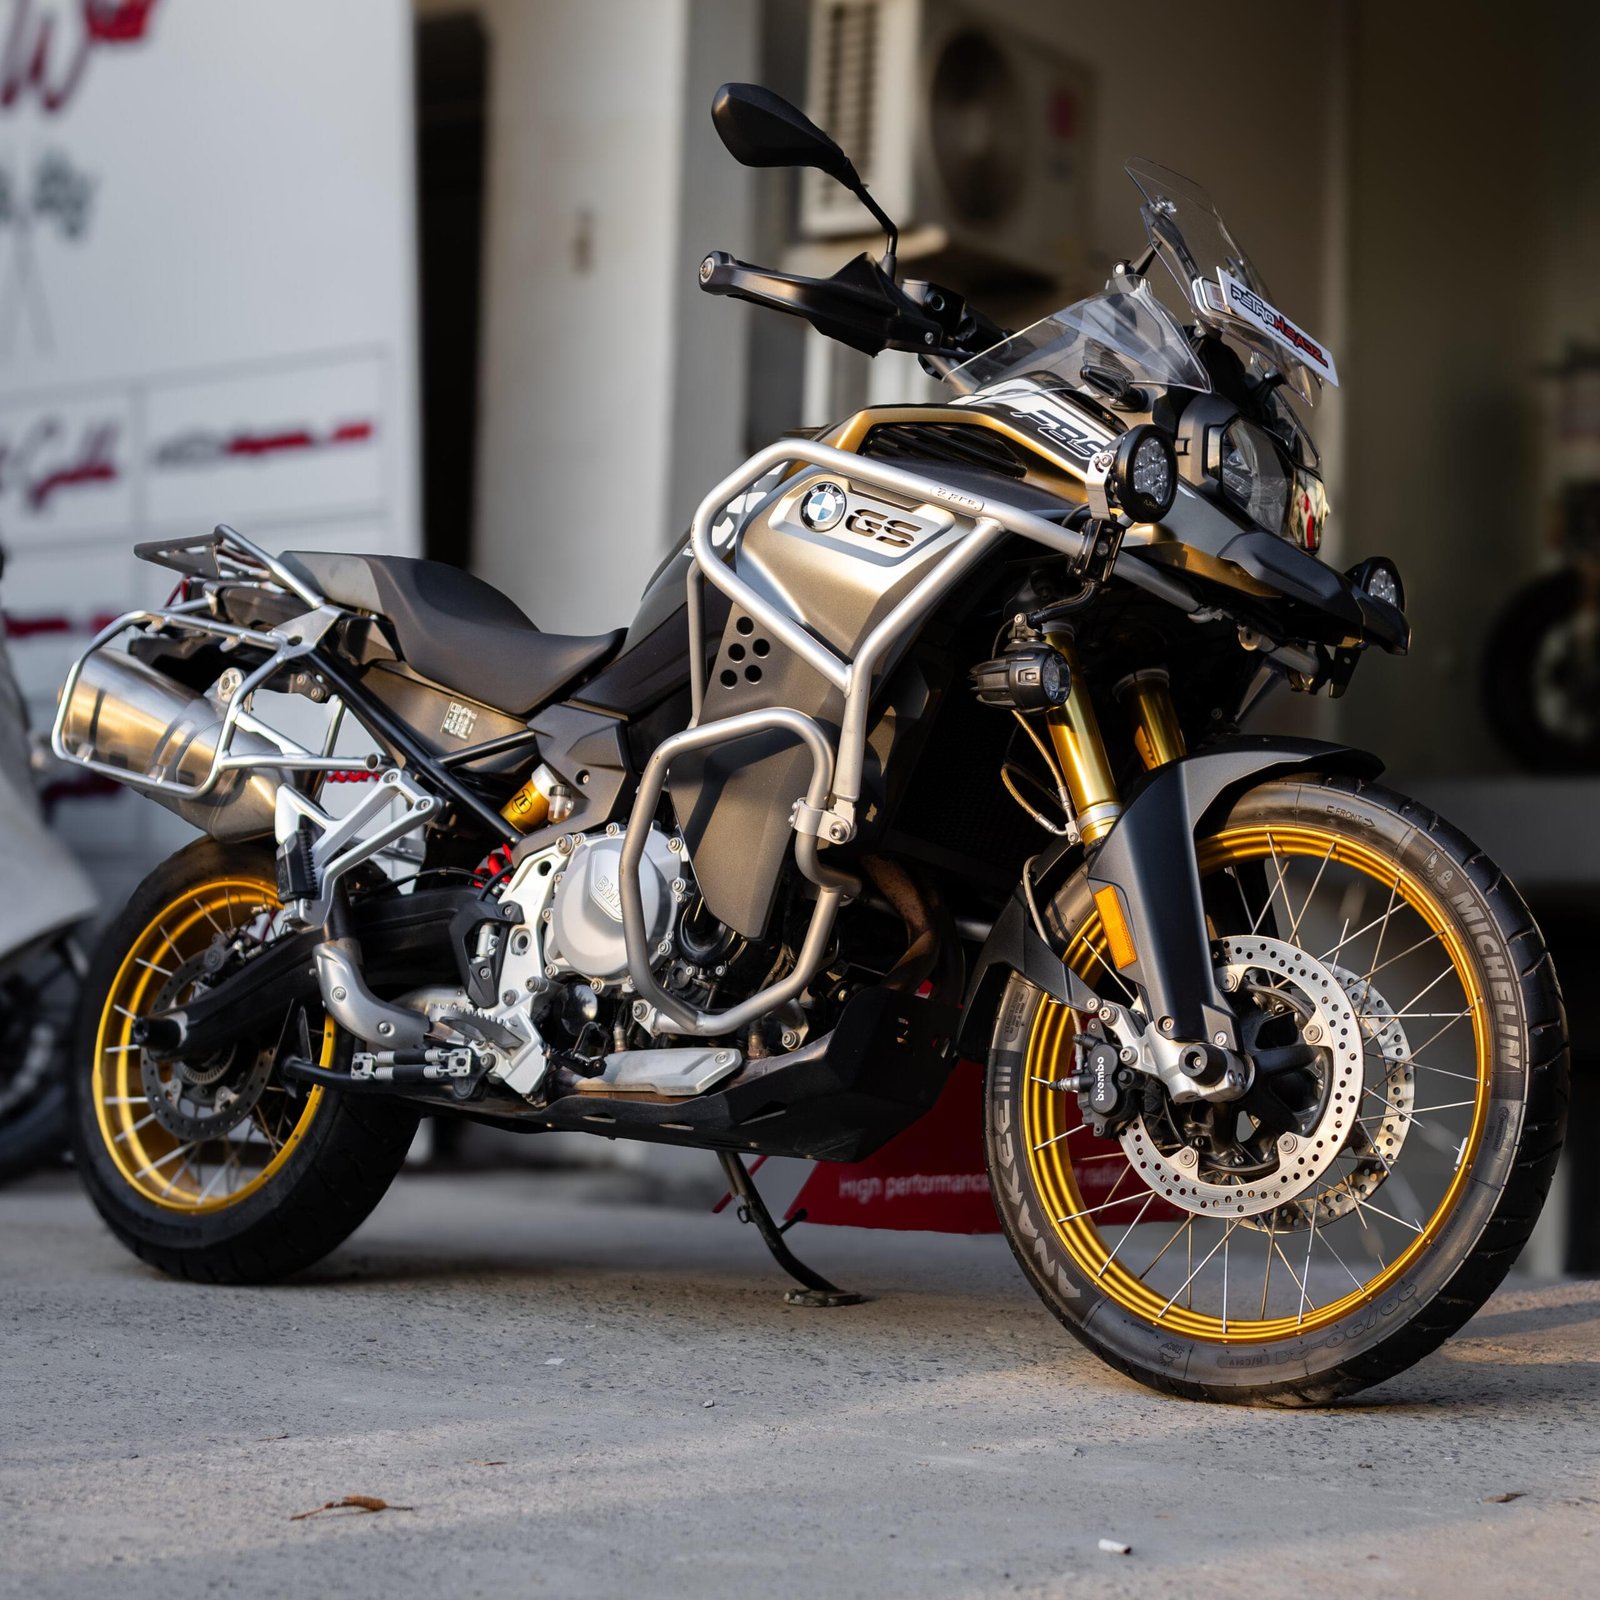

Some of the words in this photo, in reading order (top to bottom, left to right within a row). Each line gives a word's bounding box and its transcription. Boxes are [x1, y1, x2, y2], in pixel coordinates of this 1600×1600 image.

[845, 508, 923, 549] GS
[1335, 807, 1363, 823] FRONT
[595, 874, 621, 908] BM
[1451, 890, 1522, 1072] MICHELIN
[1095, 1056, 1105, 1102] brembo
[994, 1099, 1081, 1298] ANAKEE
